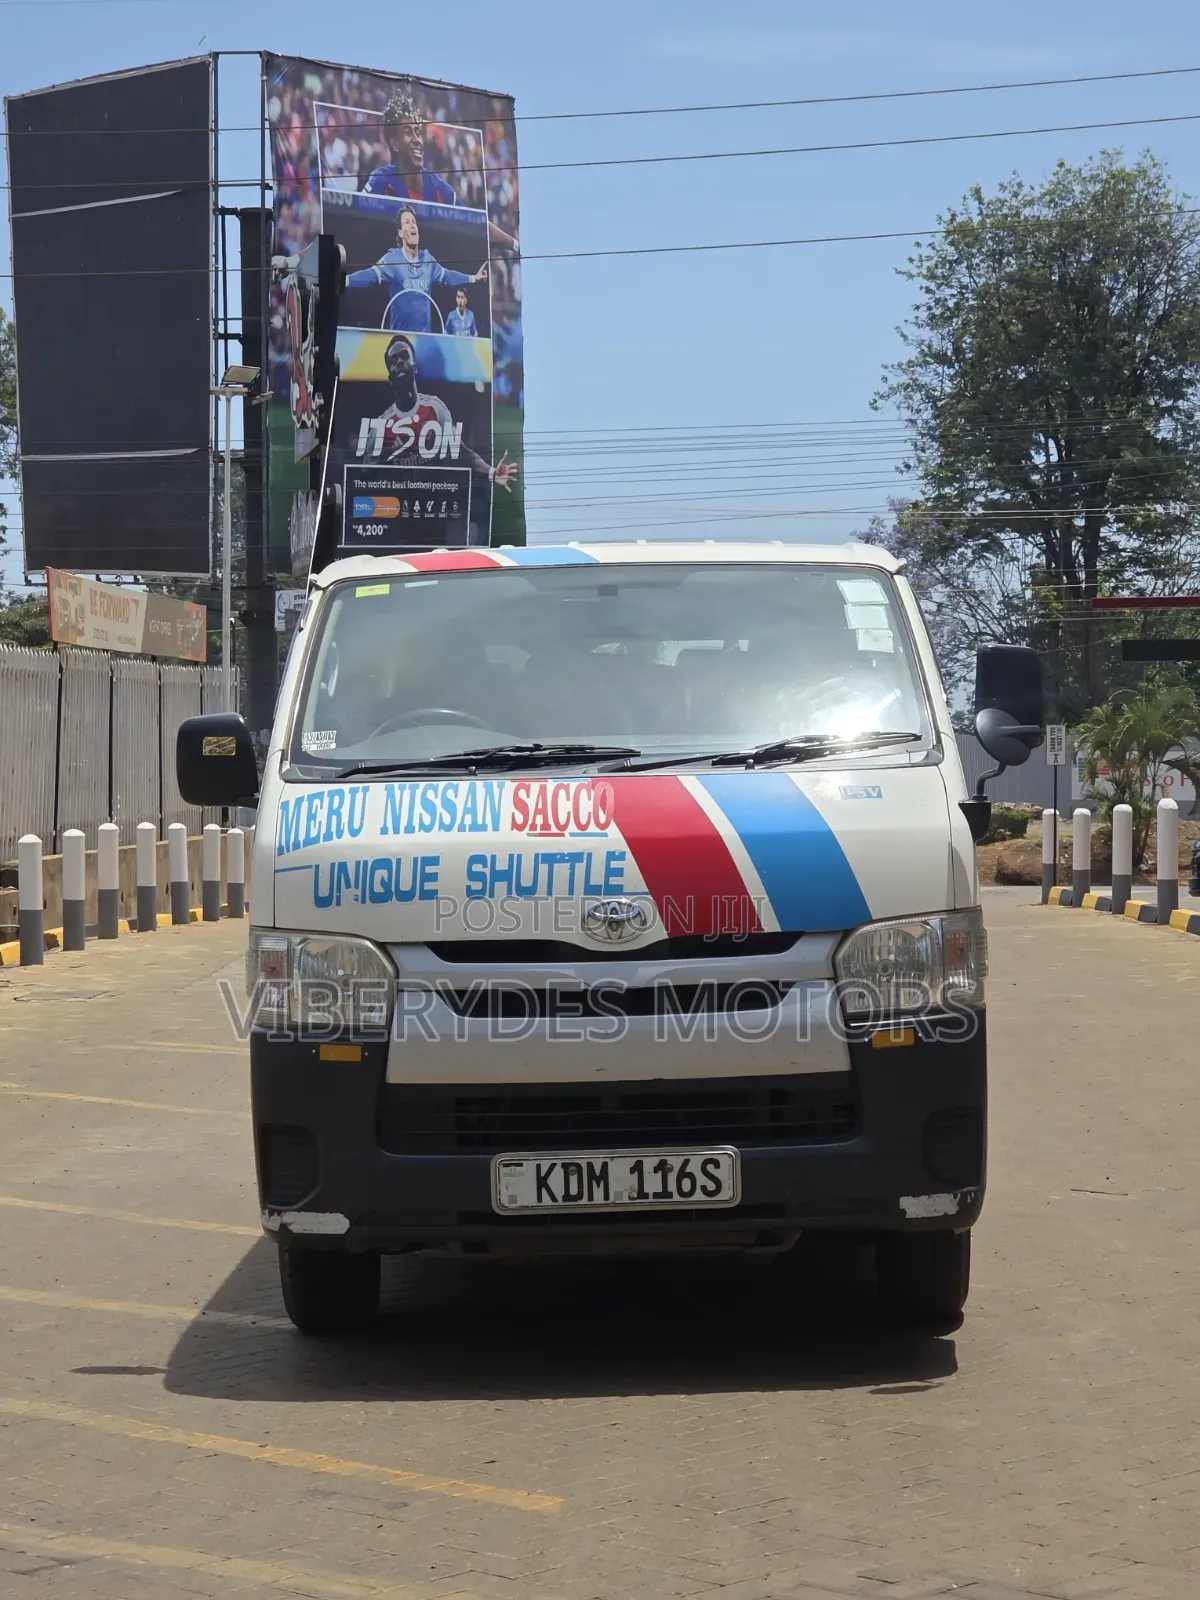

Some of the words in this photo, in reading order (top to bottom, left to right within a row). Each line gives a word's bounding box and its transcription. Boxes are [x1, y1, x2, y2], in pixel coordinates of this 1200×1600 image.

[355, 414, 420, 462] IT'S
[418, 420, 464, 460] ON
[354, 479, 367, 489] The
[367, 480, 391, 489] world's
[392, 480, 407, 490] best
[407, 480, 432, 490] football
[432, 482, 459, 493] package
[357, 524, 384, 537] 4,200
[277, 785, 370, 857] MERU
[380, 782, 506, 835] NISSAN
[511, 782, 614, 832] SACCO
[313, 855, 440, 908] UNIQUE
[466, 851, 627, 899] SHUTTLE
[535, 1160, 611, 1203] KDM
[628, 1157, 723, 1202] 116S
